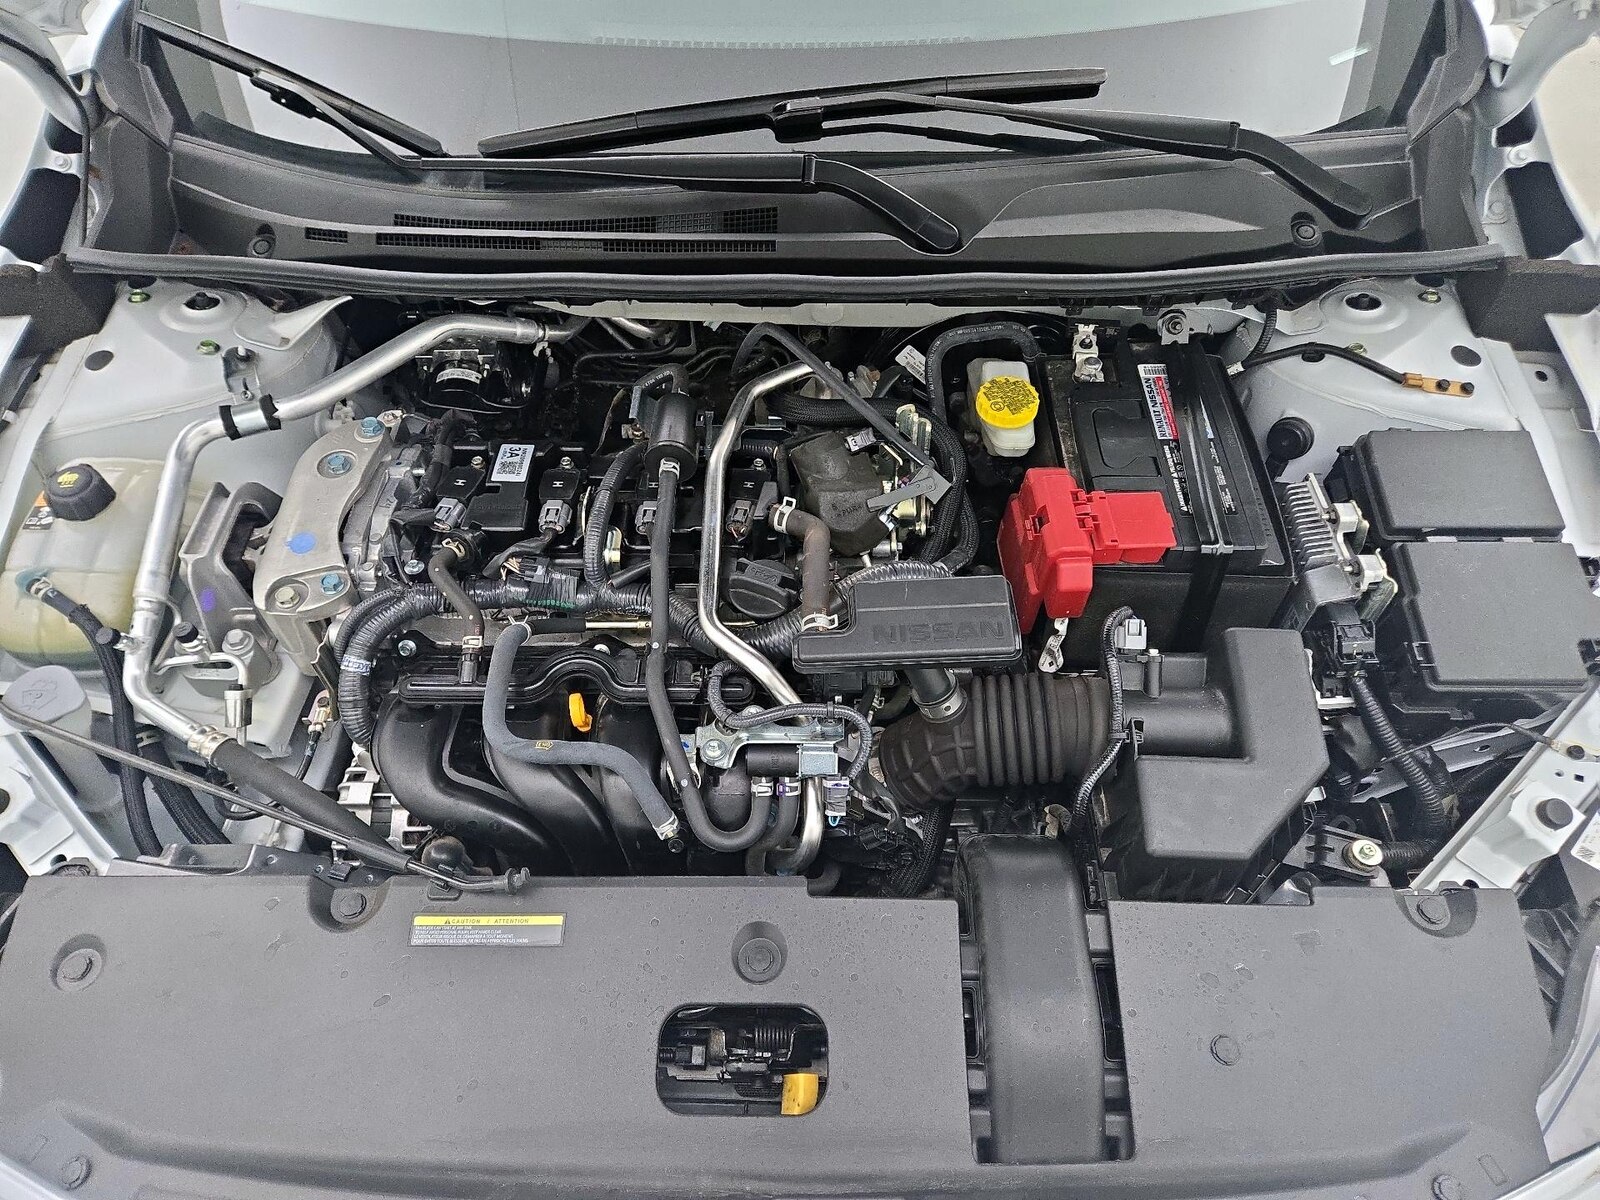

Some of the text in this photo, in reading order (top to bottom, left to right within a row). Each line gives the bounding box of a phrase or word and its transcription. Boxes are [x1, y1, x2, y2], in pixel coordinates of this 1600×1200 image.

[1144, 377, 1160, 408] NISSAN
[1153, 409, 1167, 437] RENAULT
[507, 446, 521, 458] 3A
[872, 621, 1004, 643] NISSAN
